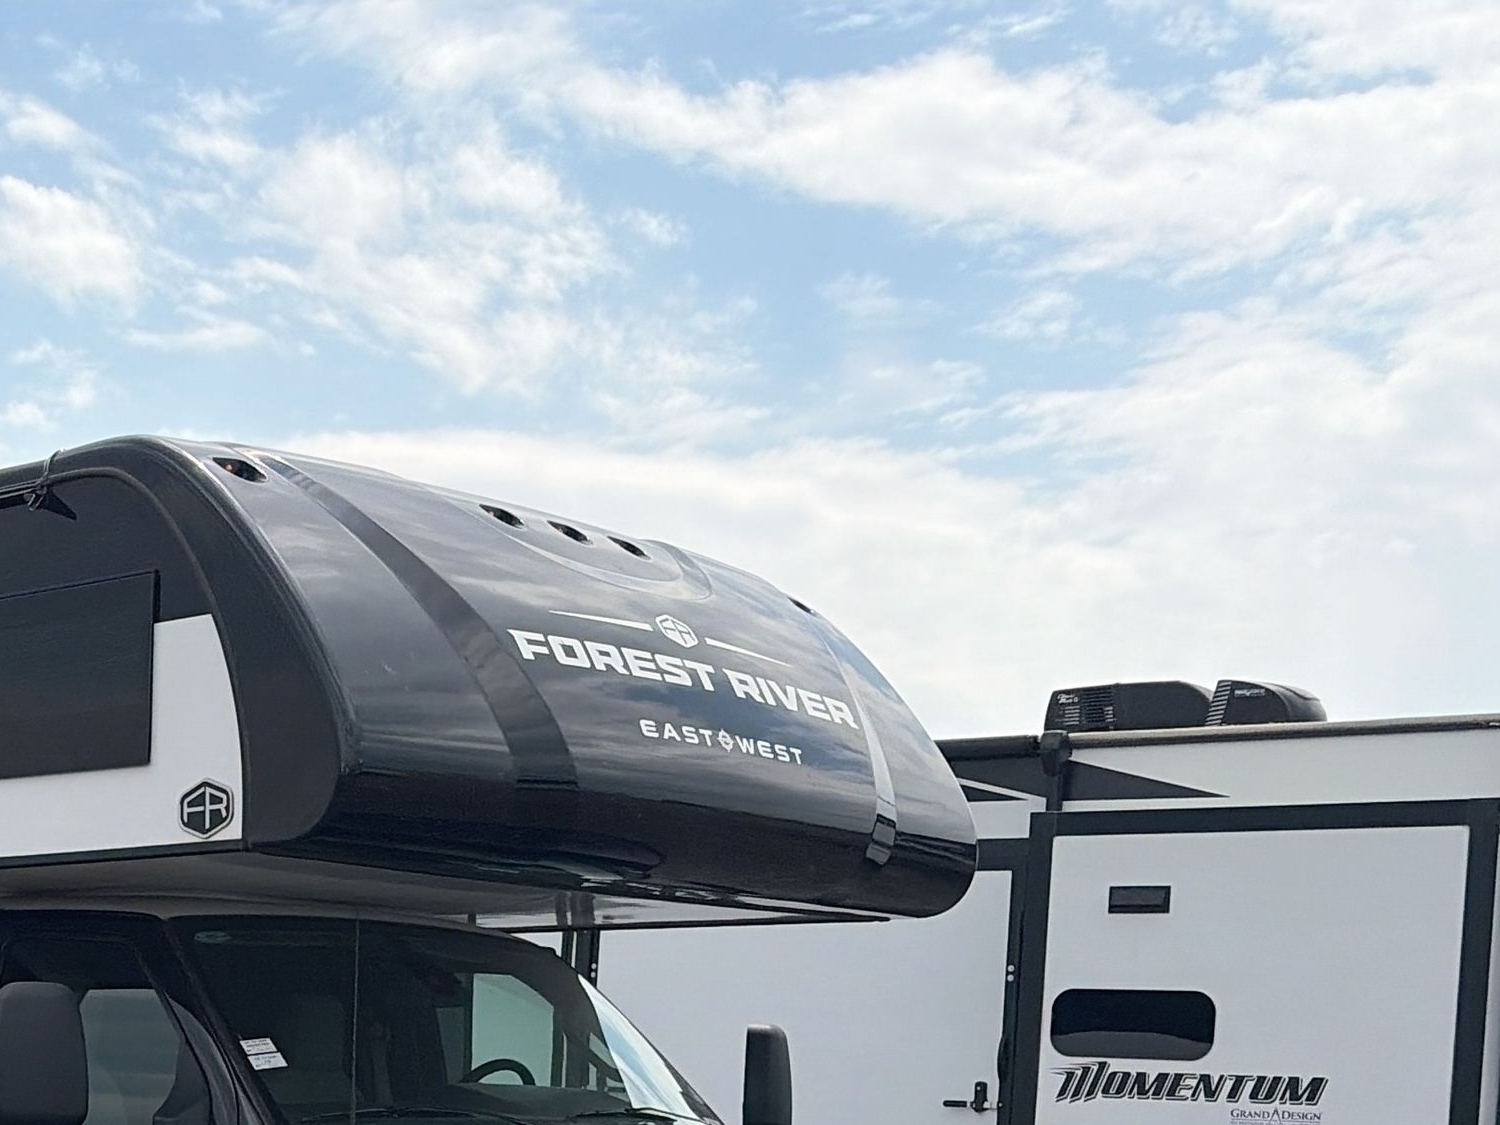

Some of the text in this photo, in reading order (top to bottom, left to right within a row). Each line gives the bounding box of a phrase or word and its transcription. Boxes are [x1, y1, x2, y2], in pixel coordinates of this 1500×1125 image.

[506, 628, 860, 730] FOREST RIVER
[1045, 1060, 1329, 1106] MOMENTUM
[1281, 1110, 1322, 1121] DESIGN
